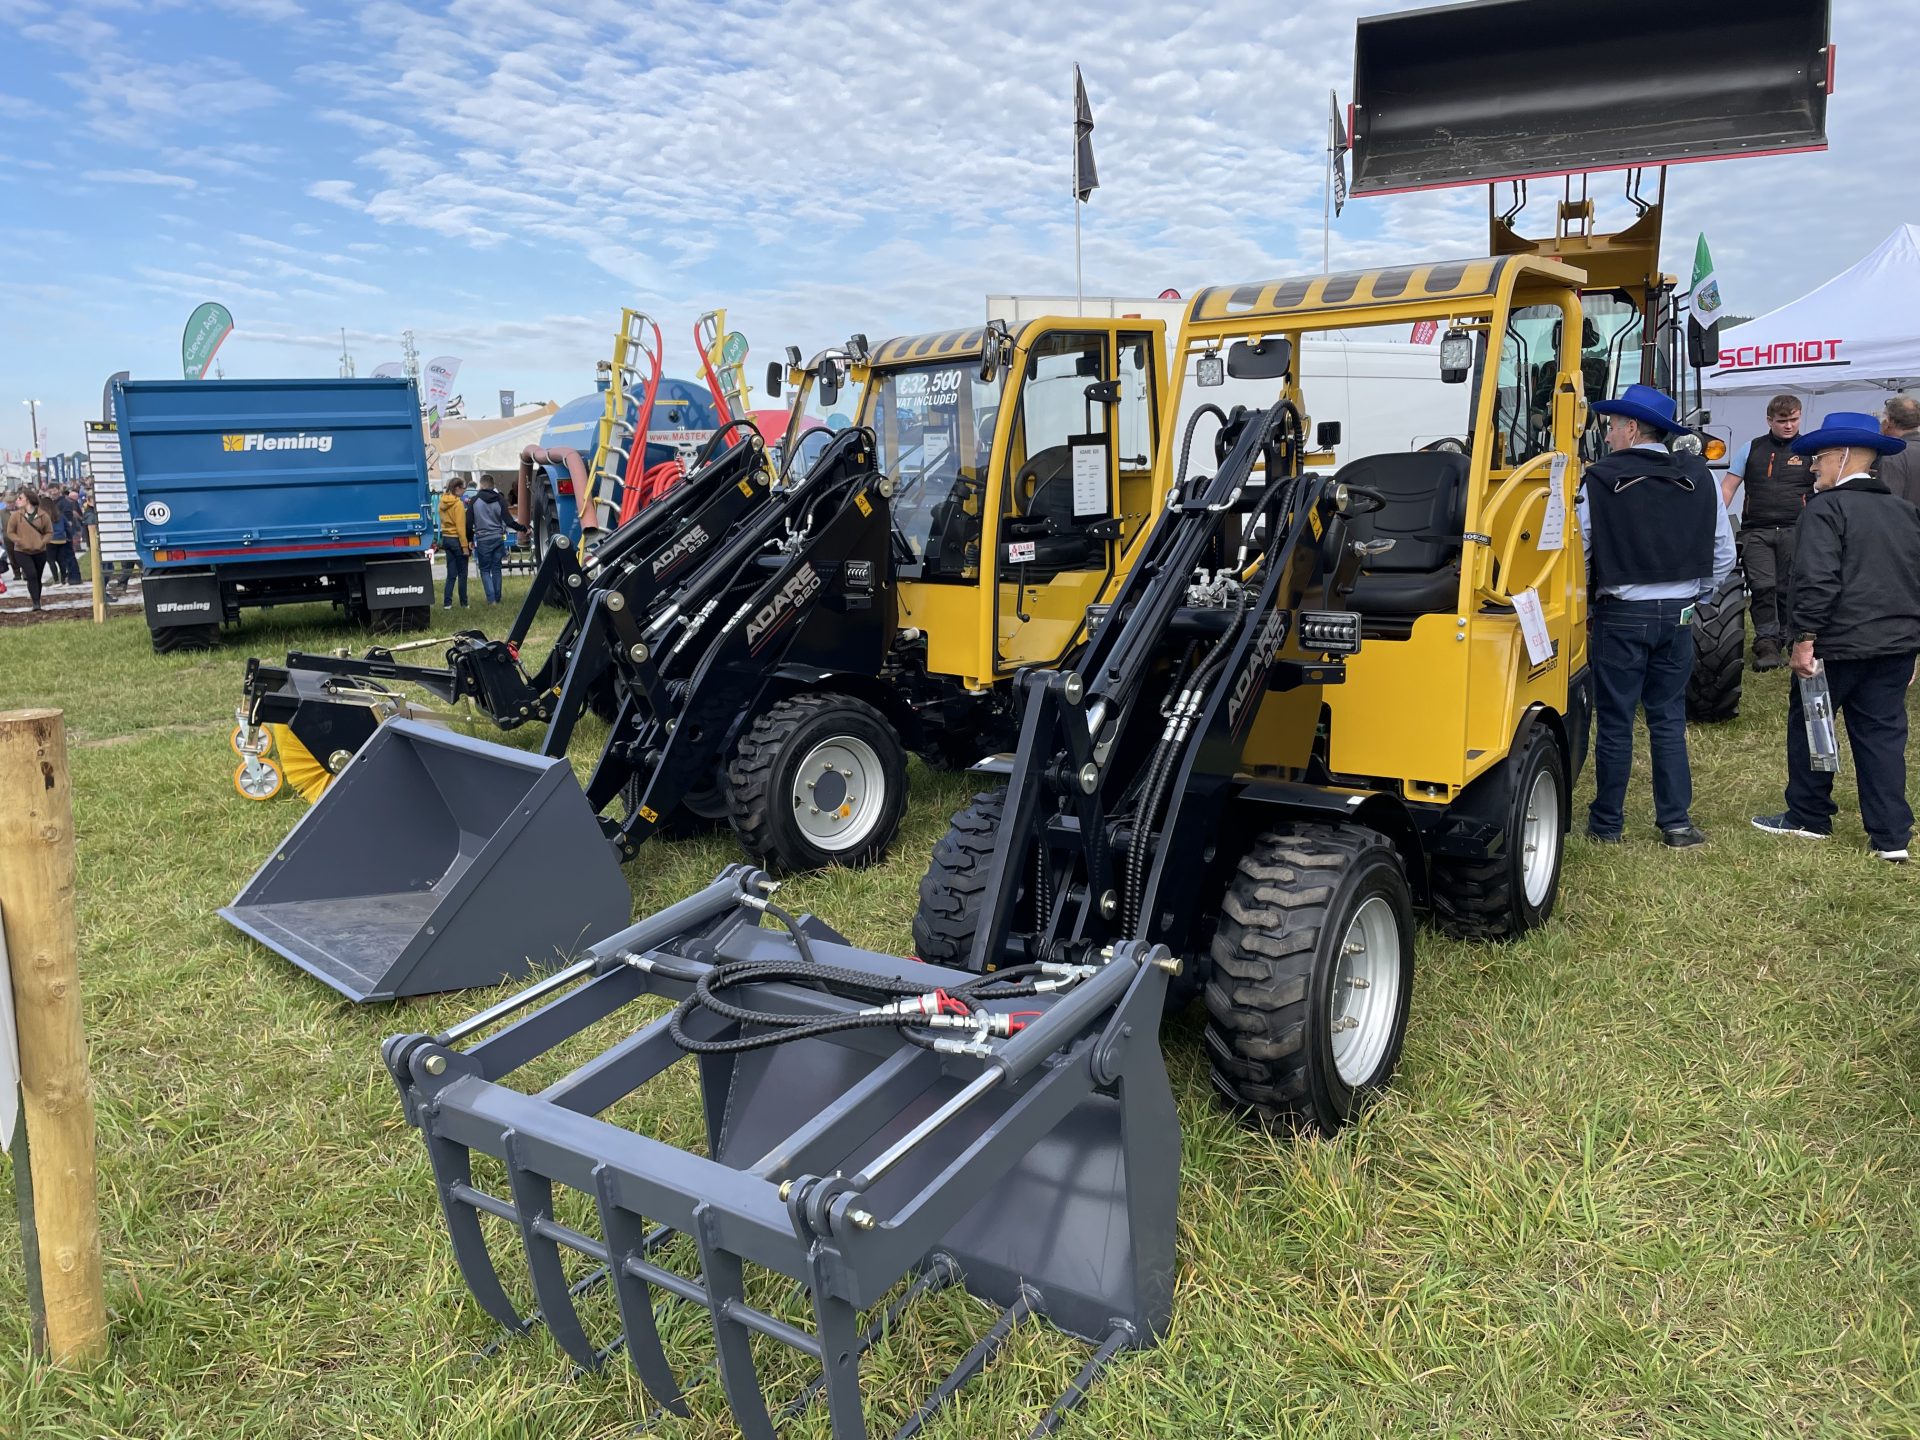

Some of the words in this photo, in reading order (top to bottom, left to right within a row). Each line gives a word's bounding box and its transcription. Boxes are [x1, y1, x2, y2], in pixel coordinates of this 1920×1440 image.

[186, 328, 206, 361] Clever
[203, 307, 220, 330] Agri
[900, 370, 962, 396] €32,500
[896, 397, 911, 408] VAT
[913, 393, 958, 406] INCLUDED
[244, 433, 333, 453] Fleming
[148, 507, 166, 518] 40
[651, 524, 706, 576] ADARE
[687, 533, 710, 554] 830
[386, 585, 424, 595] Fleming
[793, 576, 822, 608] 820
[168, 601, 210, 612] Fleming
[745, 561, 817, 646] ADARE
[1264, 623, 1286, 669] 820
[1228, 606, 1281, 727] ADARE
